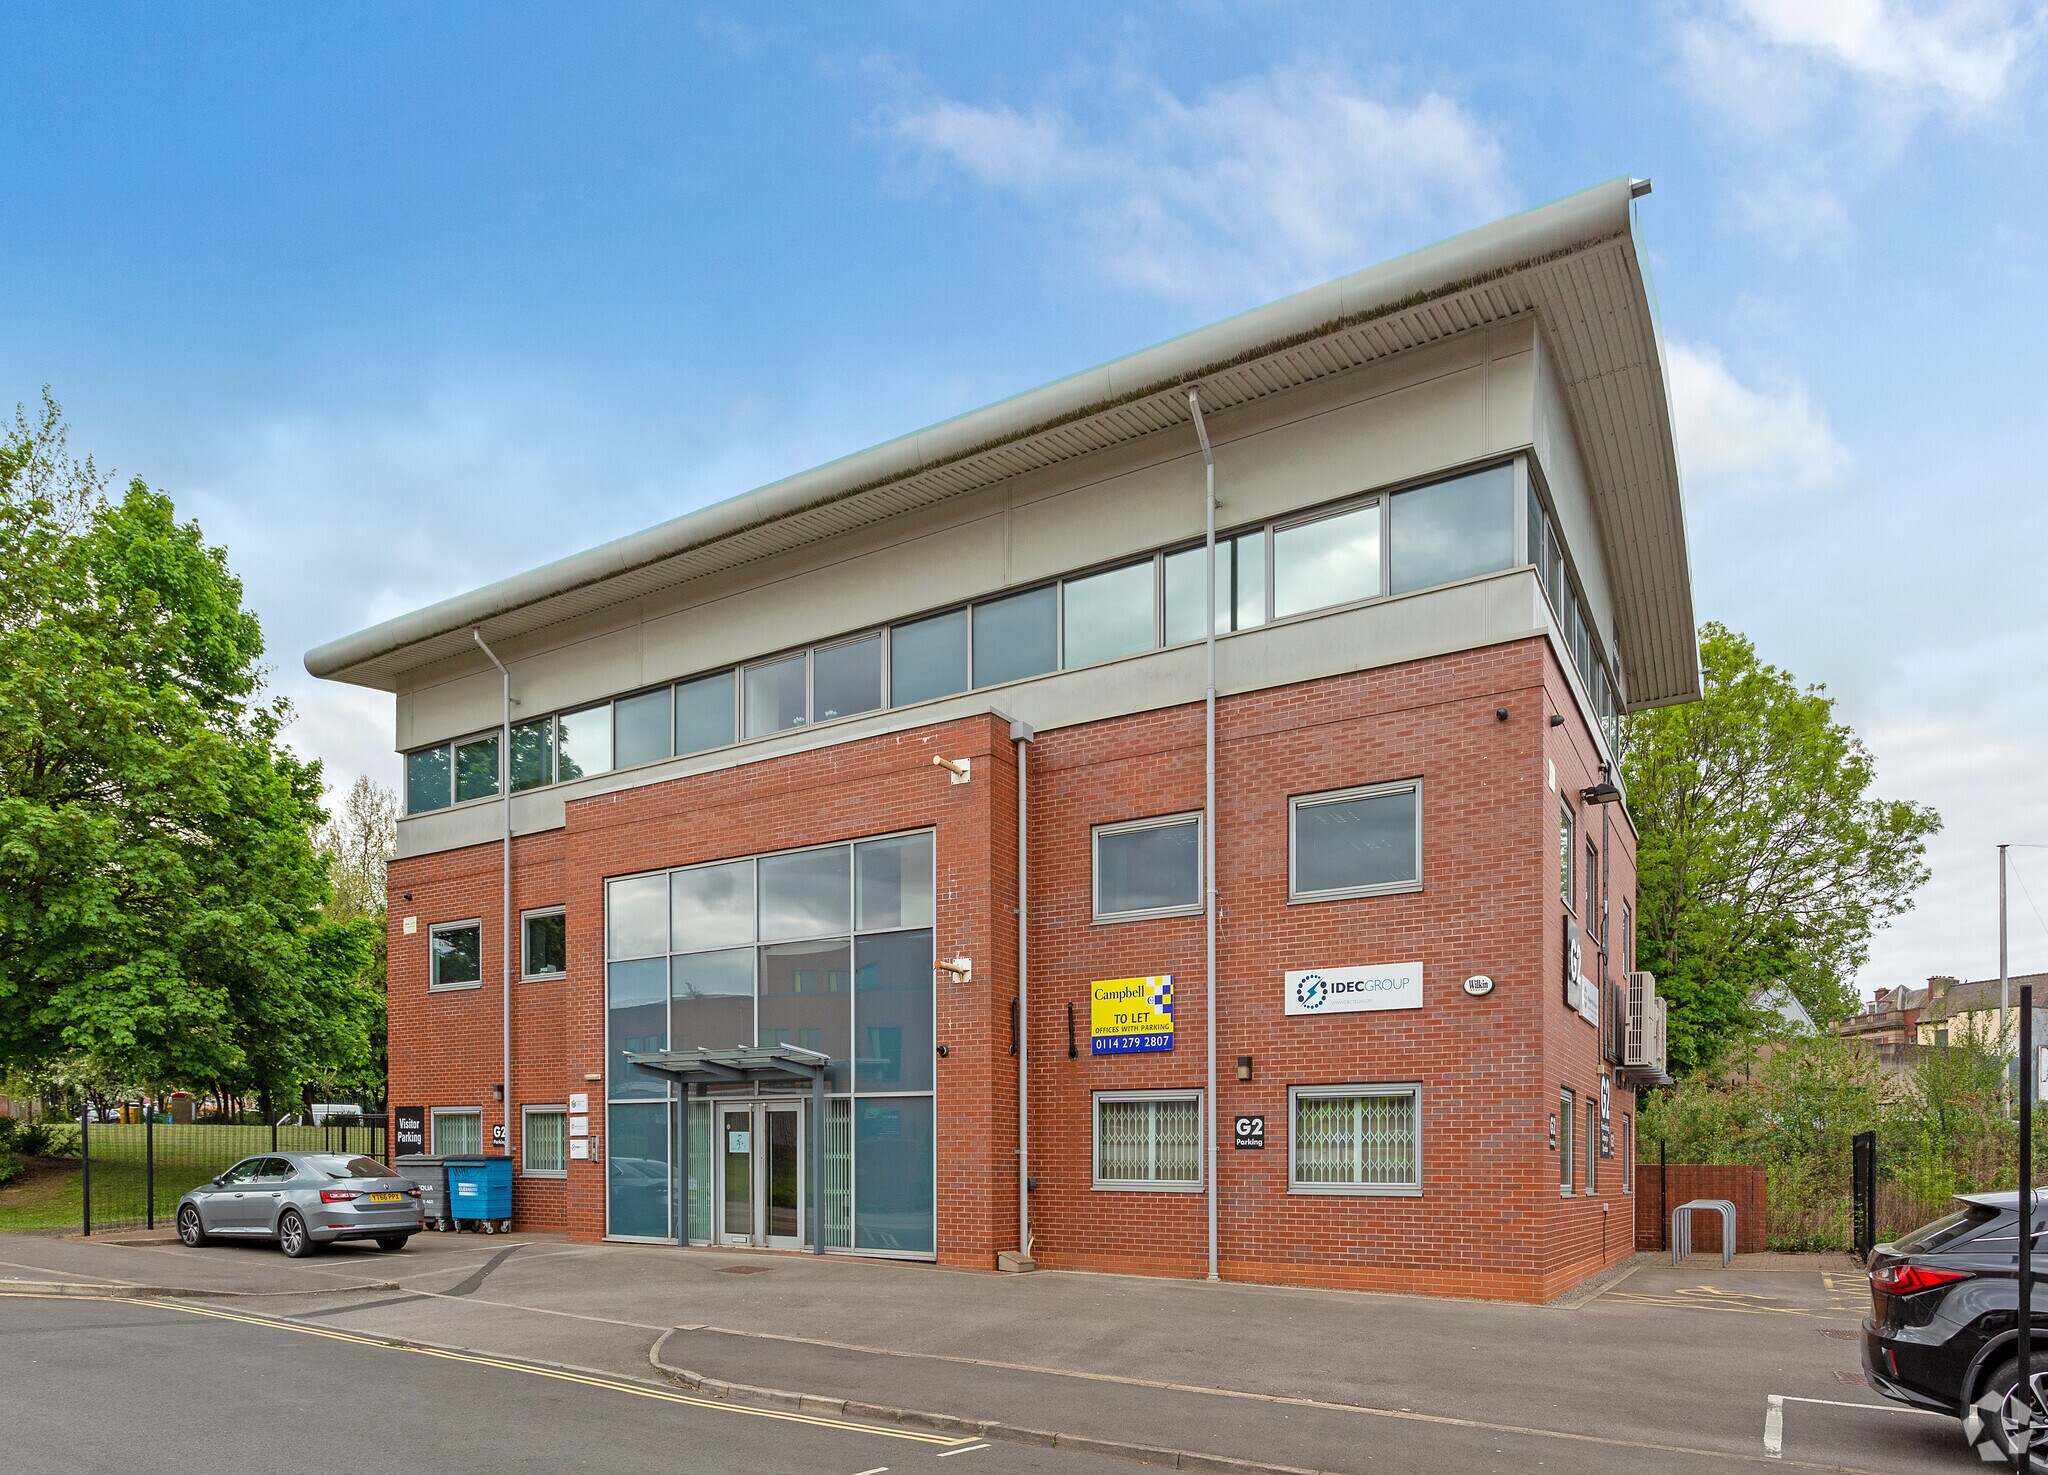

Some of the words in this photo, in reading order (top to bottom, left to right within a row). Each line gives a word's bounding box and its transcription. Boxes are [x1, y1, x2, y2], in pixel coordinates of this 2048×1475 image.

[1331, 977, 1410, 994] IDECGROUP
[1468, 979, 1489, 989] Wilkin
[1094, 985, 1145, 1003] Campbell
[1114, 1013, 1128, 1024] TO
[1132, 1012, 1150, 1023] LET
[1095, 1026, 1119, 1034] OFFICES
[1140, 1023, 1170, 1031] PARKING
[1096, 1038, 1119, 1049] 0114
[1122, 1037, 1140, 1048] 279
[1144, 1035, 1169, 1047] 2807
[1600, 1075, 1610, 1120] G2
[399, 1118, 420, 1130] Visitor
[1236, 1118, 1263, 1136] G2
[397, 1131, 422, 1145] Parking
[1236, 1138, 1263, 1147] Parking
[388, 1192, 400, 1200] PPX
